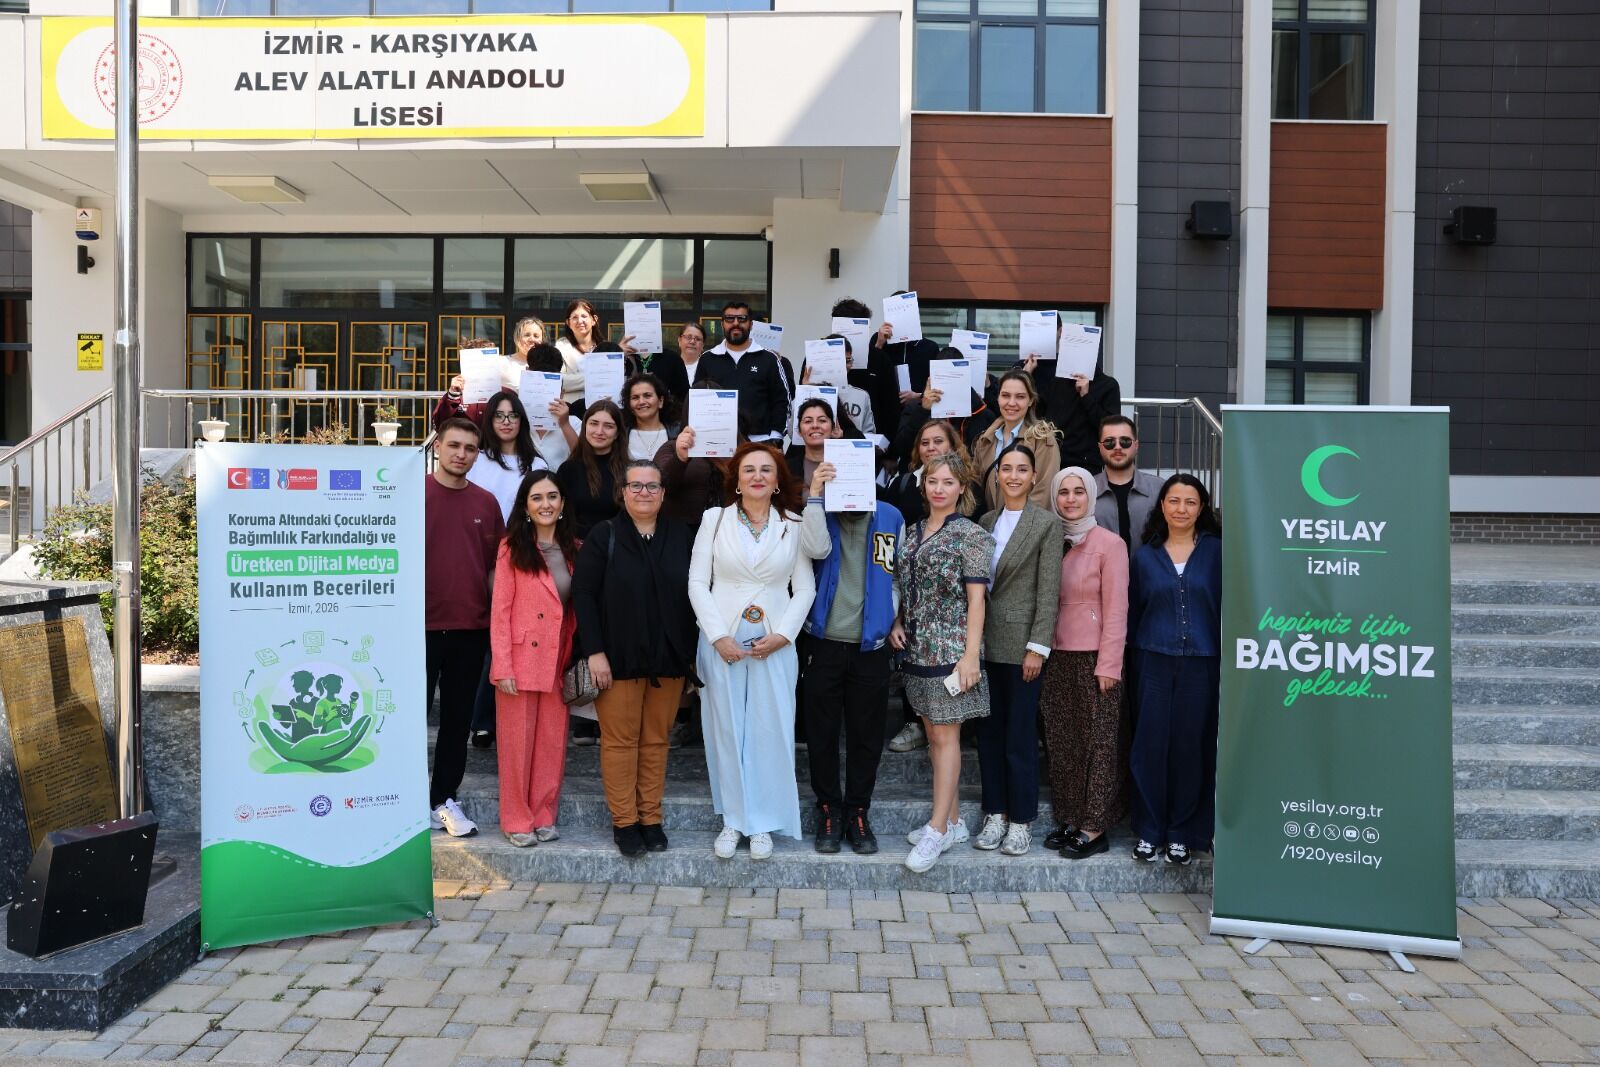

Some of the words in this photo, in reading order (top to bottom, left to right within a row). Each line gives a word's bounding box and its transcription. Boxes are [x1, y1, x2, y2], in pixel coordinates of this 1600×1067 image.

[264, 30, 344, 54] İZMİR
[370, 33, 538, 58] KARŞIYAKA
[234, 72, 308, 90] ALEV
[318, 70, 415, 90] ALATLI
[426, 69, 564, 89] ANADOLU
[354, 102, 443, 126] LİSESİ
[228, 514, 276, 526] Koruma
[279, 514, 331, 526] Altındaki
[334, 513, 396, 528] Çocuklarda
[228, 530, 298, 546] Bağımlılık
[301, 530, 378, 546] Farkındalığı
[382, 534, 396, 544] ve
[231, 554, 294, 572] Üretken
[298, 554, 342, 574] Dijital
[346, 554, 394, 572] Medya
[1307, 556, 1360, 576] İZMİR
[230, 582, 308, 598] Kullanım
[314, 579, 395, 596] Becerileri
[316, 602, 339, 613] 2026
[1258, 607, 1352, 638] hepimiz
[1360, 614, 1411, 642] için
[1236, 634, 1435, 678] BAĞIMSIZ
[1283, 668, 1388, 707] gelecek...
[1281, 799, 1384, 820] yesilay.org.tr
[1281, 844, 1382, 869] /1920yesilay
